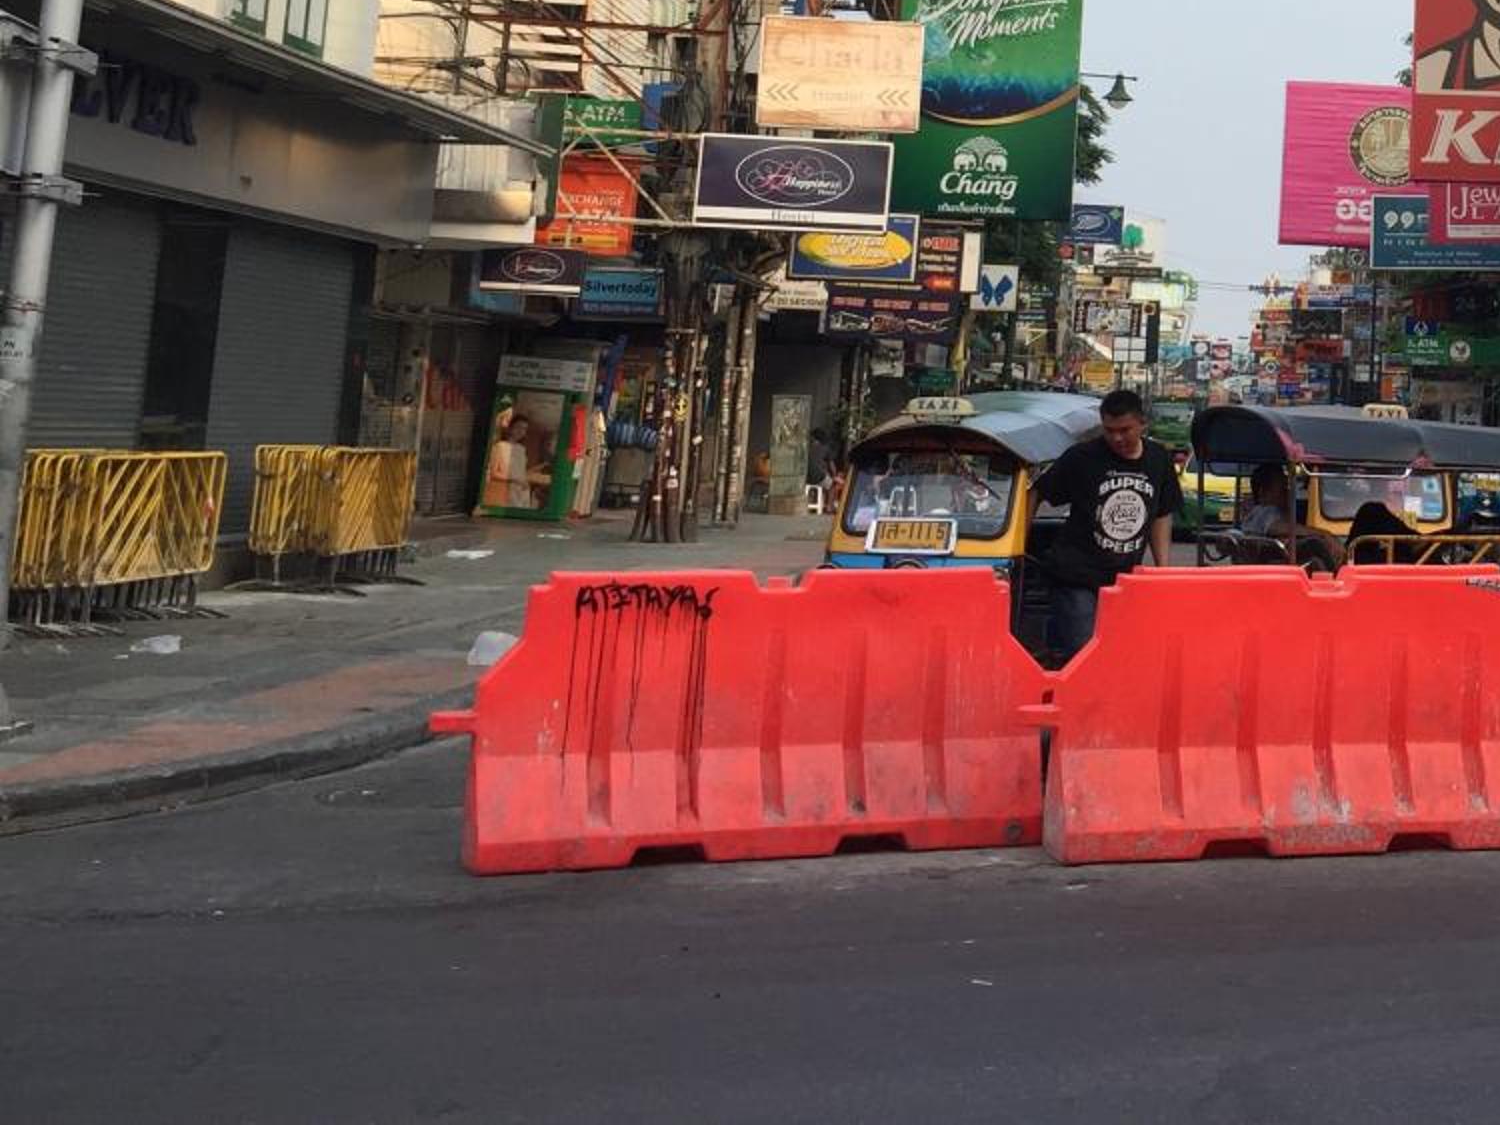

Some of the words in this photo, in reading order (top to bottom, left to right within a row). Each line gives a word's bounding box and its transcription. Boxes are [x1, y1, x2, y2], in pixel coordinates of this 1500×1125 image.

[946, 7, 1060, 50] Moments
[940, 172, 1018, 200] Chang
[584, 280, 656, 297] Silvertoday
[918, 400, 959, 410] TAXI
[1099, 476, 1154, 497] SUPER
